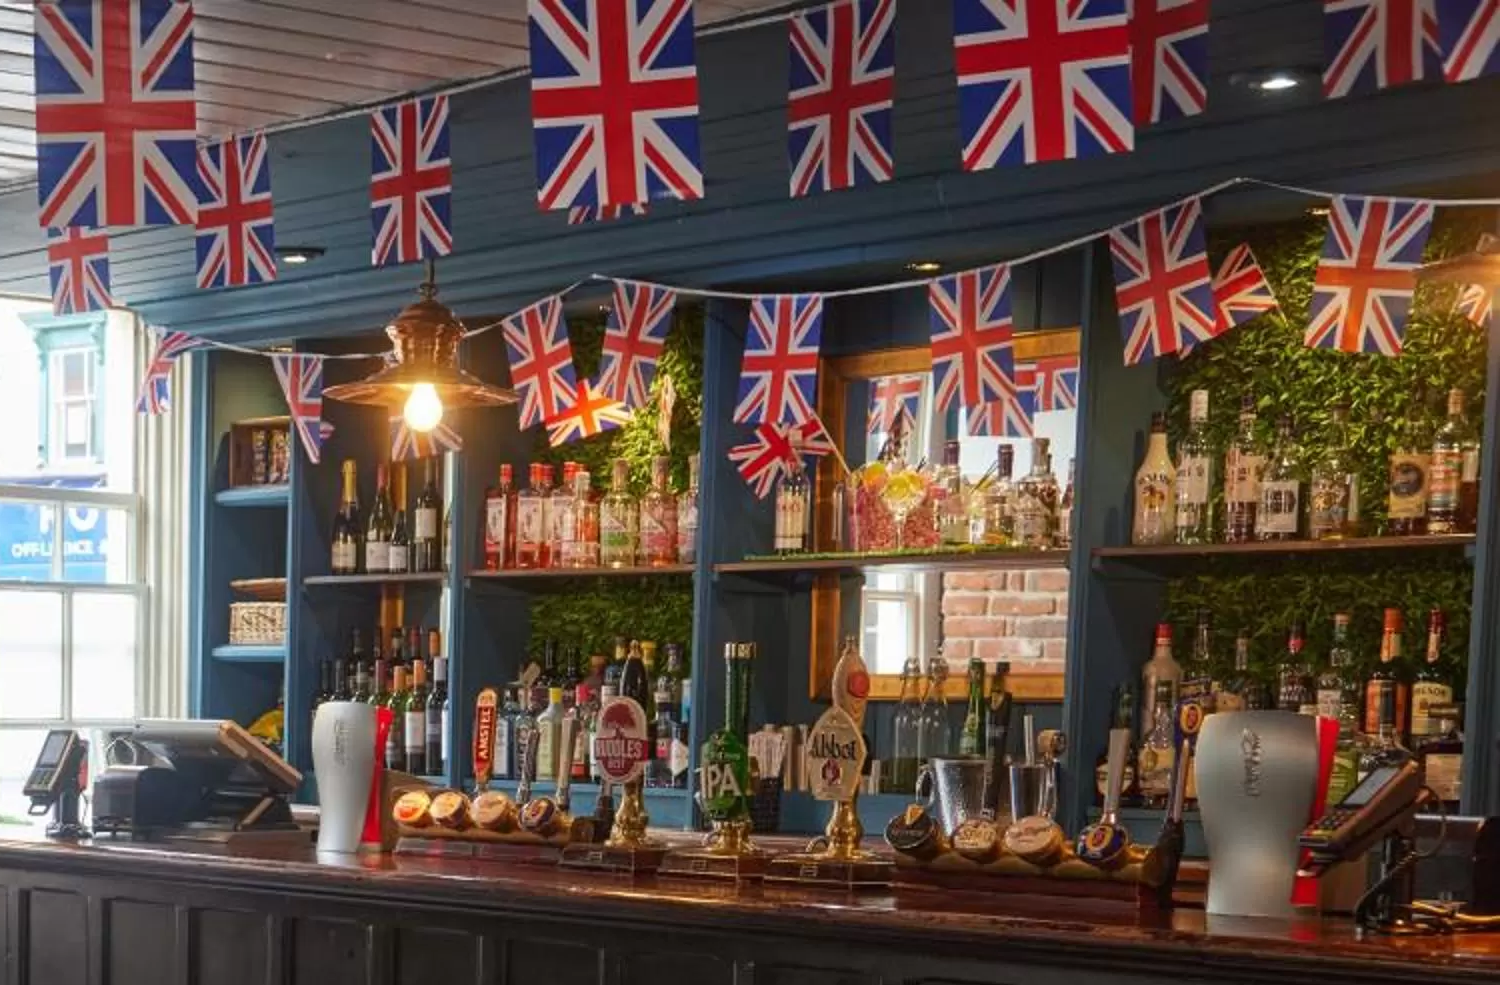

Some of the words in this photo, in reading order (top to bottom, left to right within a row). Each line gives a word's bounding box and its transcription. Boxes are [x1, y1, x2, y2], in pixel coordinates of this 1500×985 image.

[478, 707, 491, 760] AMSTEL
[808, 732, 856, 761] Abbot
[701, 763, 741, 800] IPA
